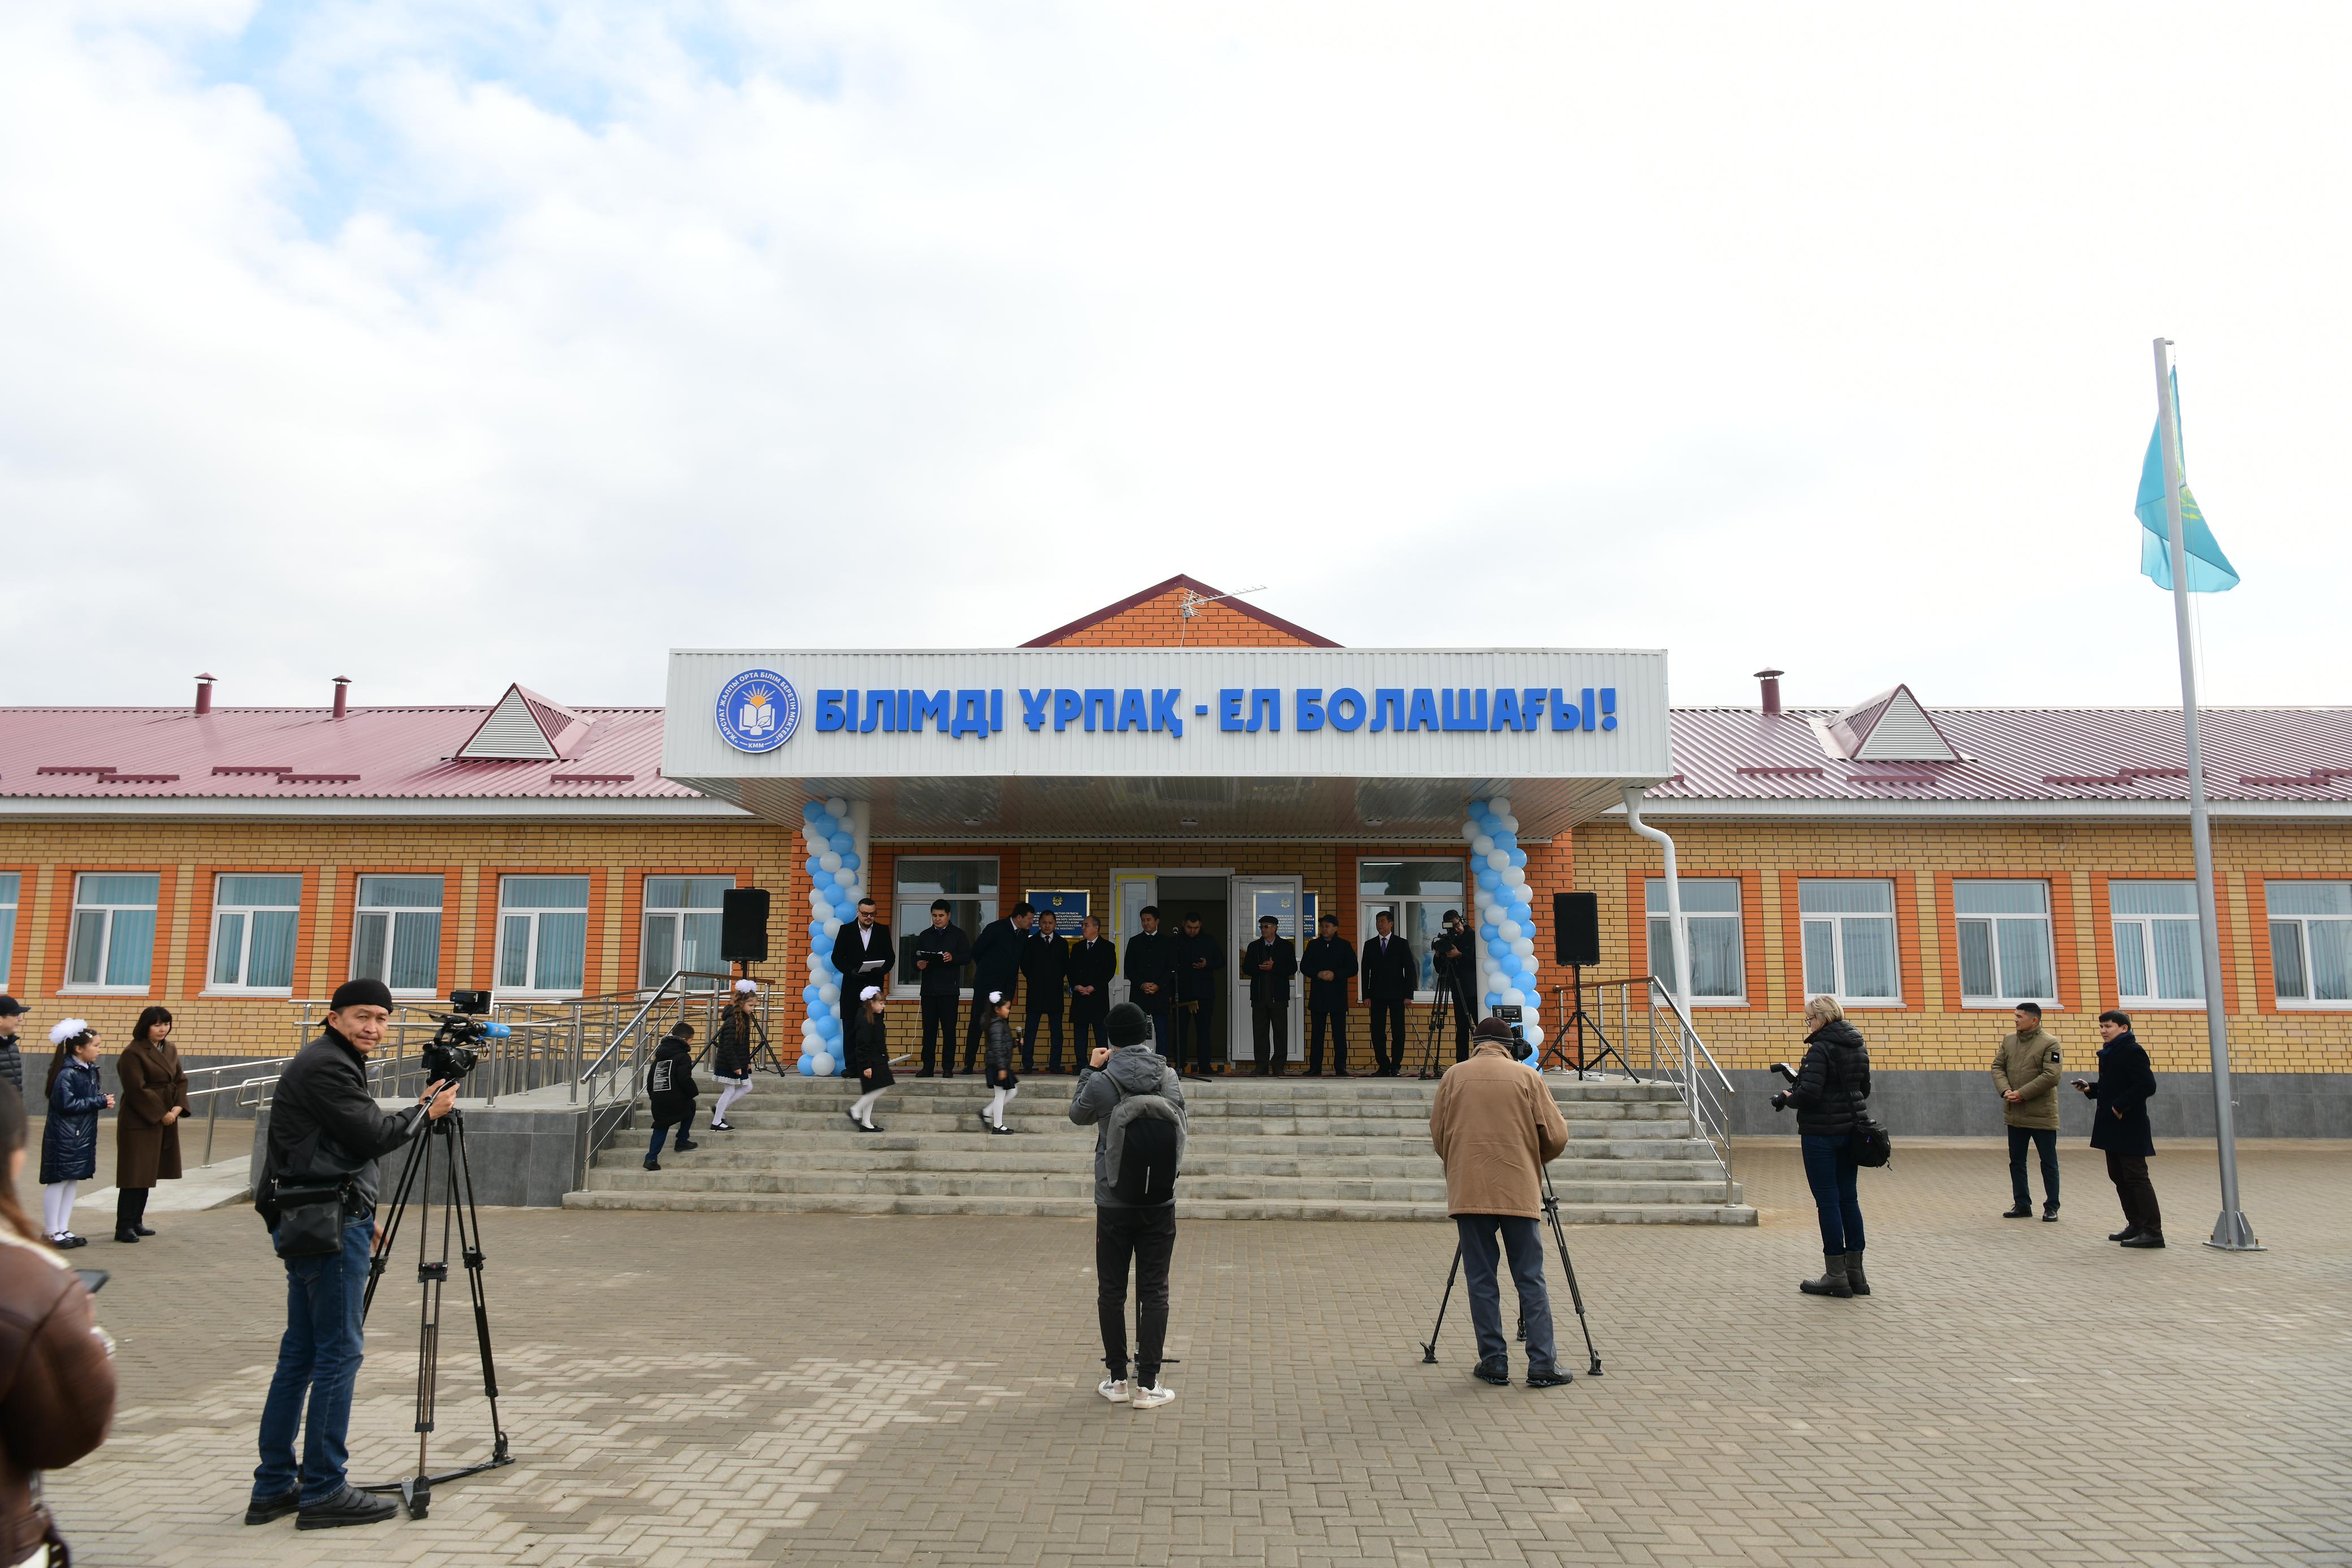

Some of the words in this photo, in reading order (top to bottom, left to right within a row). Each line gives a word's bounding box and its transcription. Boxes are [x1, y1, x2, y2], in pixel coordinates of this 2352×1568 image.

[719, 679, 740, 707] ЖАЛПЫ
[740, 672, 759, 682] ОРТА
[760, 672, 781, 683] БІЛІМ
[780, 681, 796, 710] БЕРЕТІН
[815, 689, 1003, 739] БІЛІМДІ
[1018, 688, 1183, 738] ҰРПАҚ
[1220, 688, 1281, 732] ЕЛ
[1296, 687, 1618, 731] БОЛАШАҒЫ!
